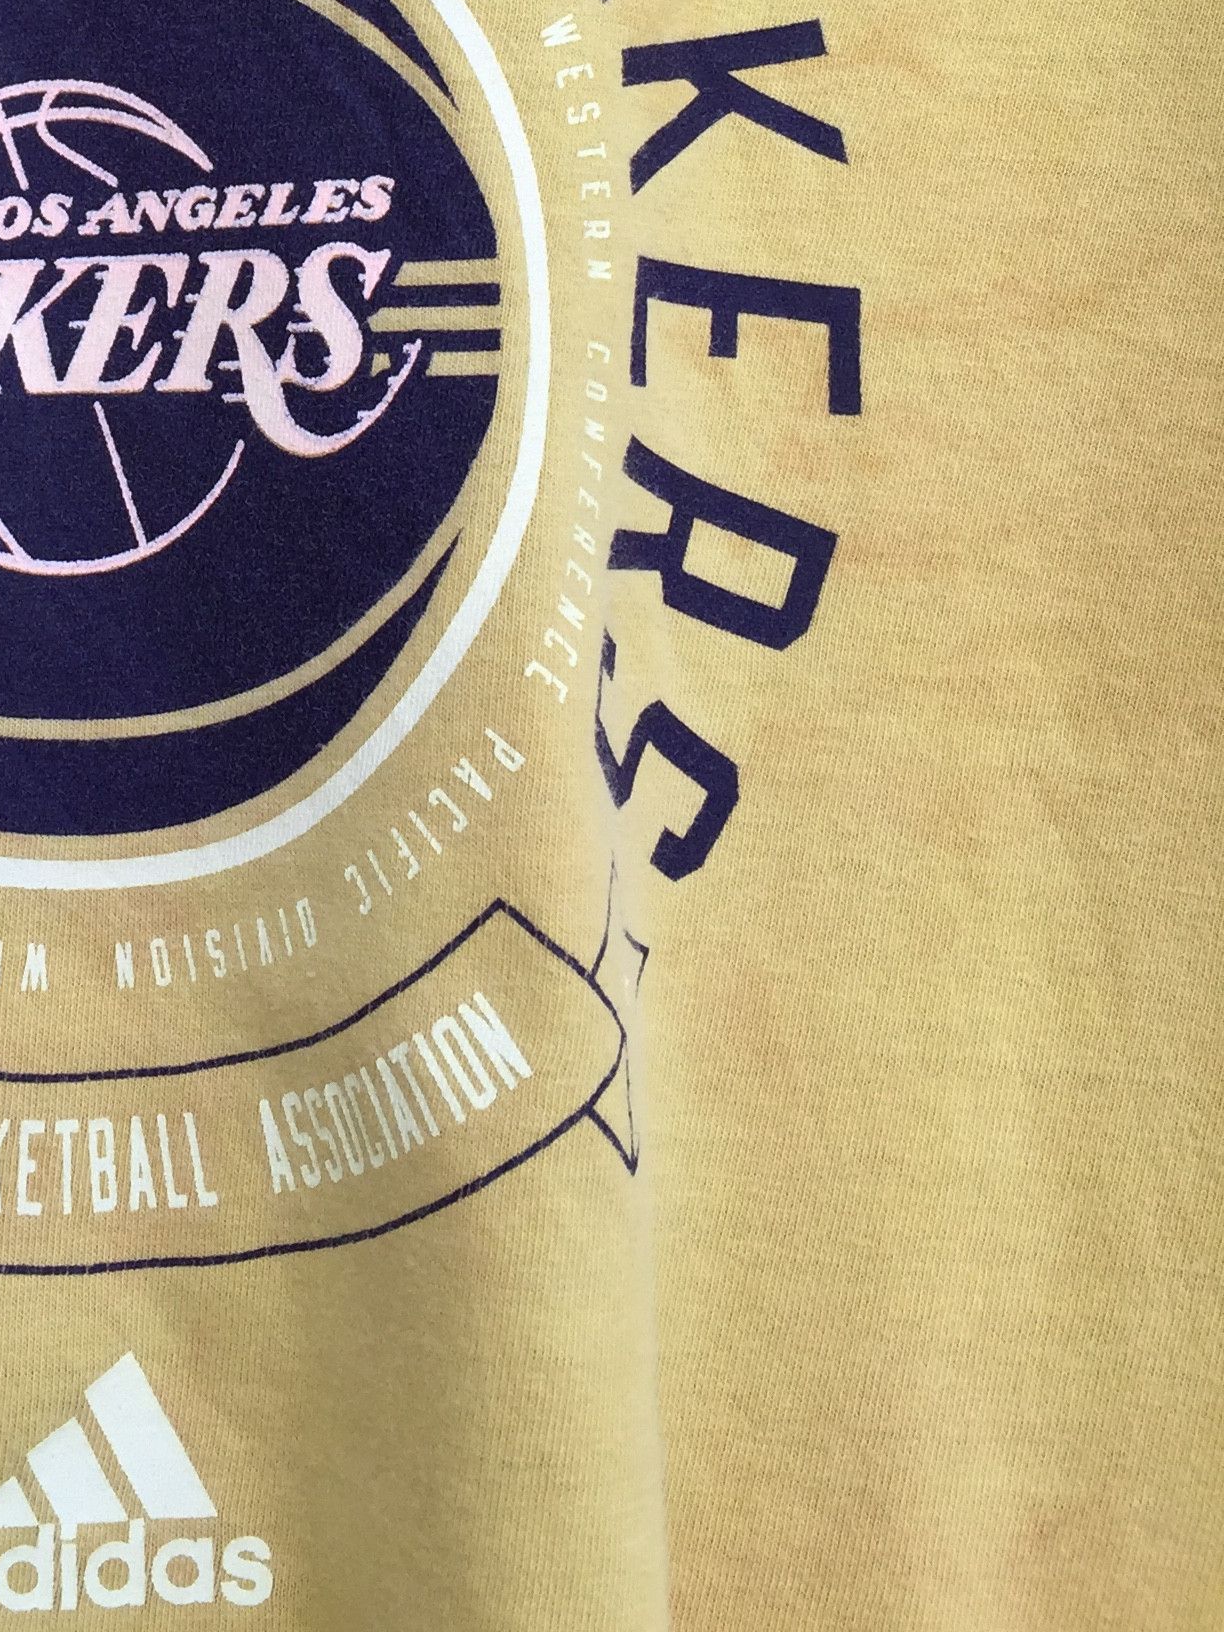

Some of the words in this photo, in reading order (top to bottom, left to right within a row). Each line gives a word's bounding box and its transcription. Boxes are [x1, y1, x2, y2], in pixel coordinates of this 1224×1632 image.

[77, 176, 395, 236] ANGELES
[541, 13, 612, 280] WESTERN
[524, 340, 611, 704] CONFERENCE
[344, 727, 525, 915] PACIFIC
[116, 897, 319, 989] DIVISION
[259, 990, 534, 1194] ASSOCIATION
